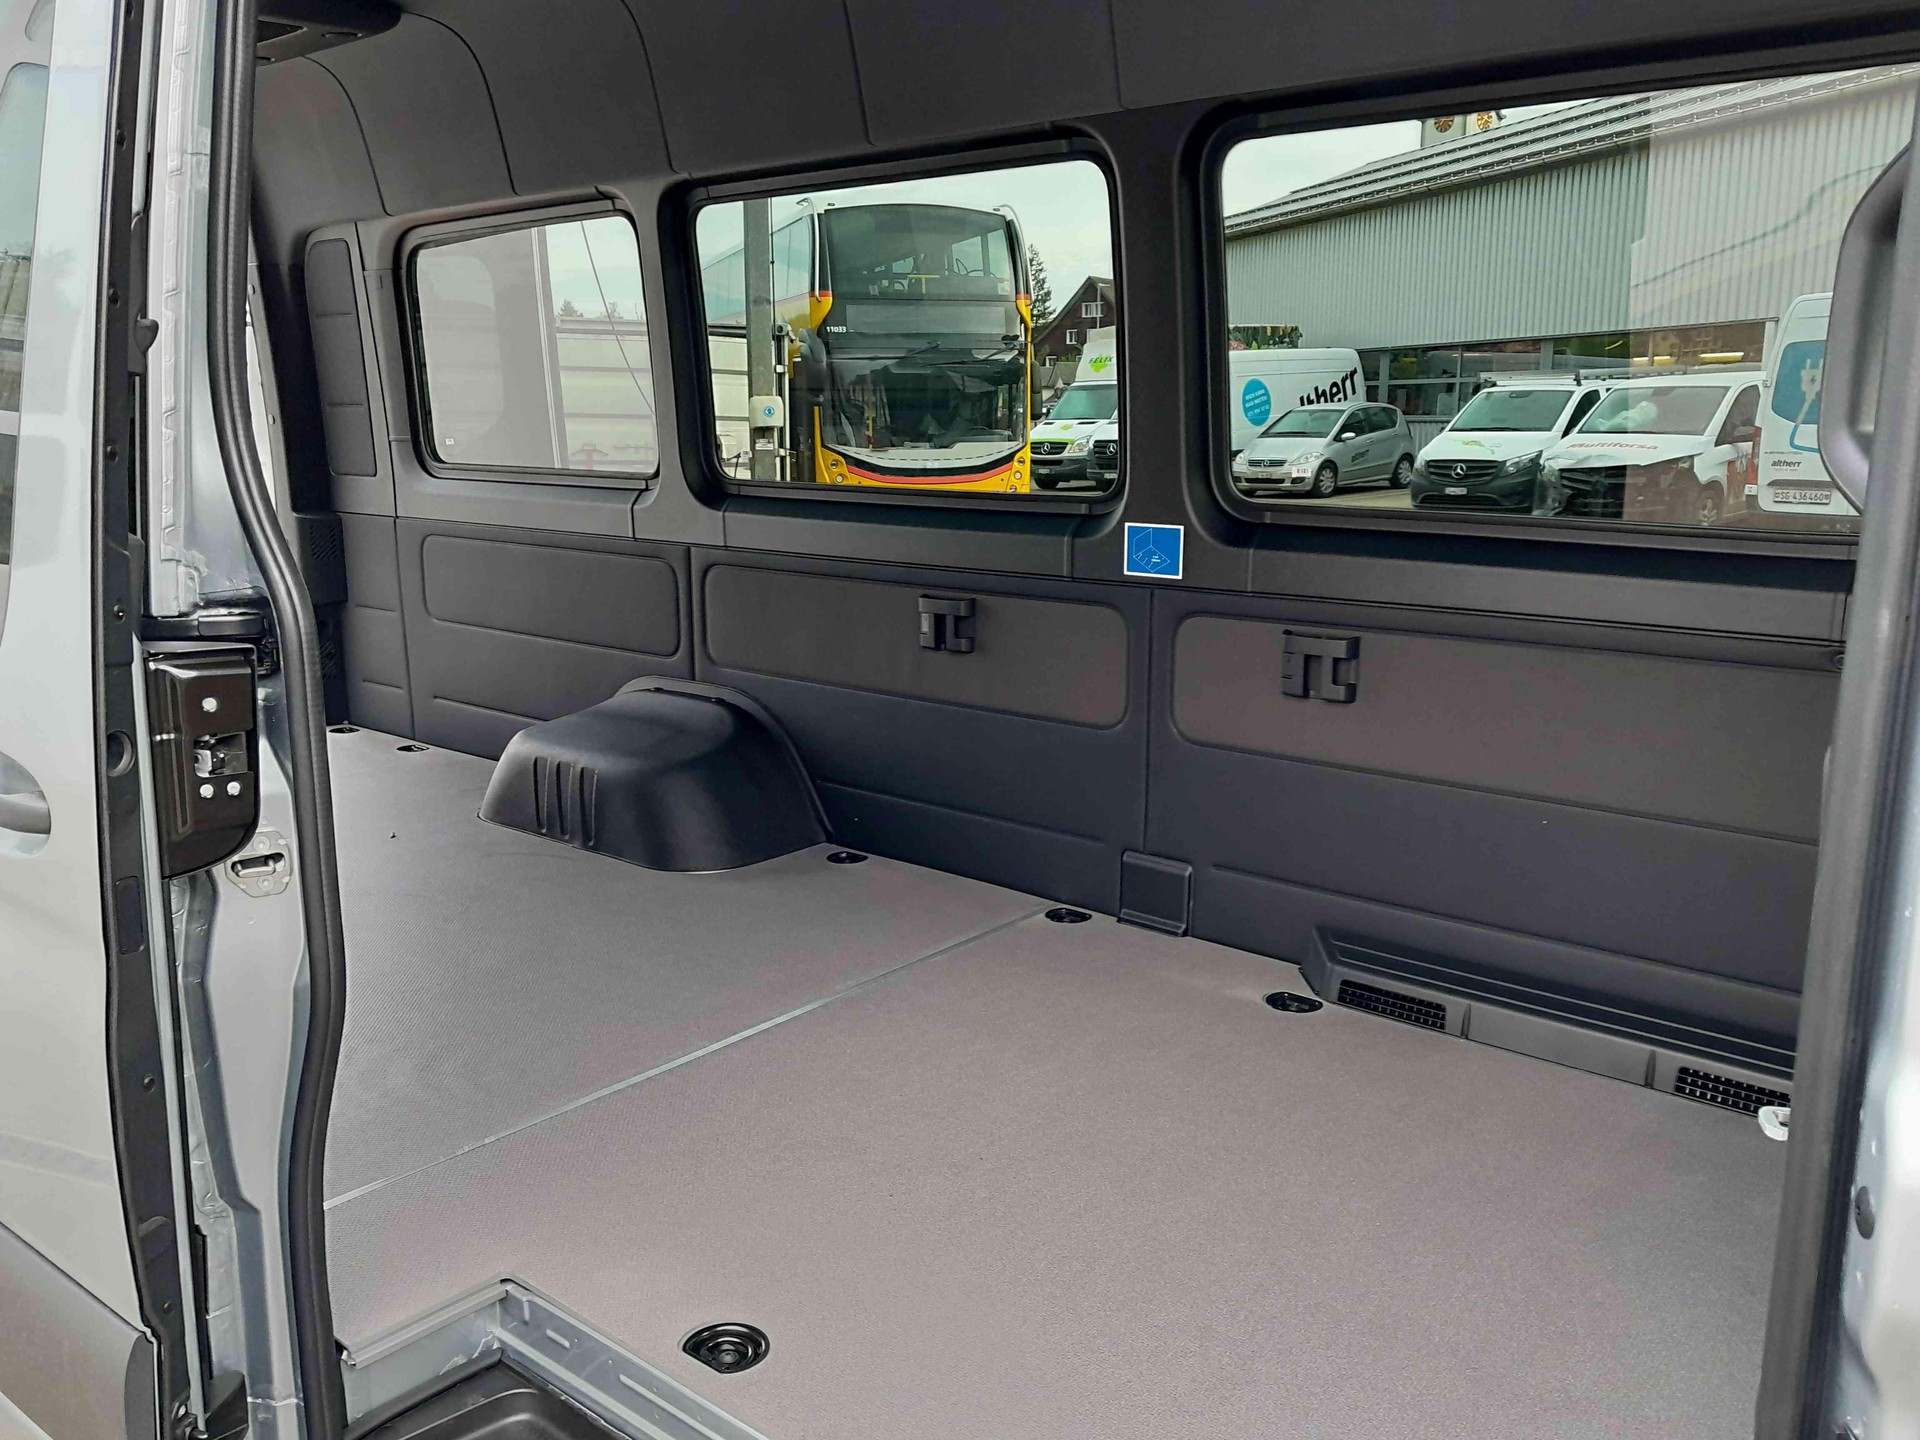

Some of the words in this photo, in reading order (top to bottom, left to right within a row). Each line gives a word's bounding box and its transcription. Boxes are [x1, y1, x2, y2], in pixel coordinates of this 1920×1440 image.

[826, 325, 847, 333] 11033
[1088, 356, 1113, 364] FELIX
[1299, 366, 1358, 407] ltherr
[1771, 459, 1802, 468] altherr
[1780, 491, 1790, 500] SG
